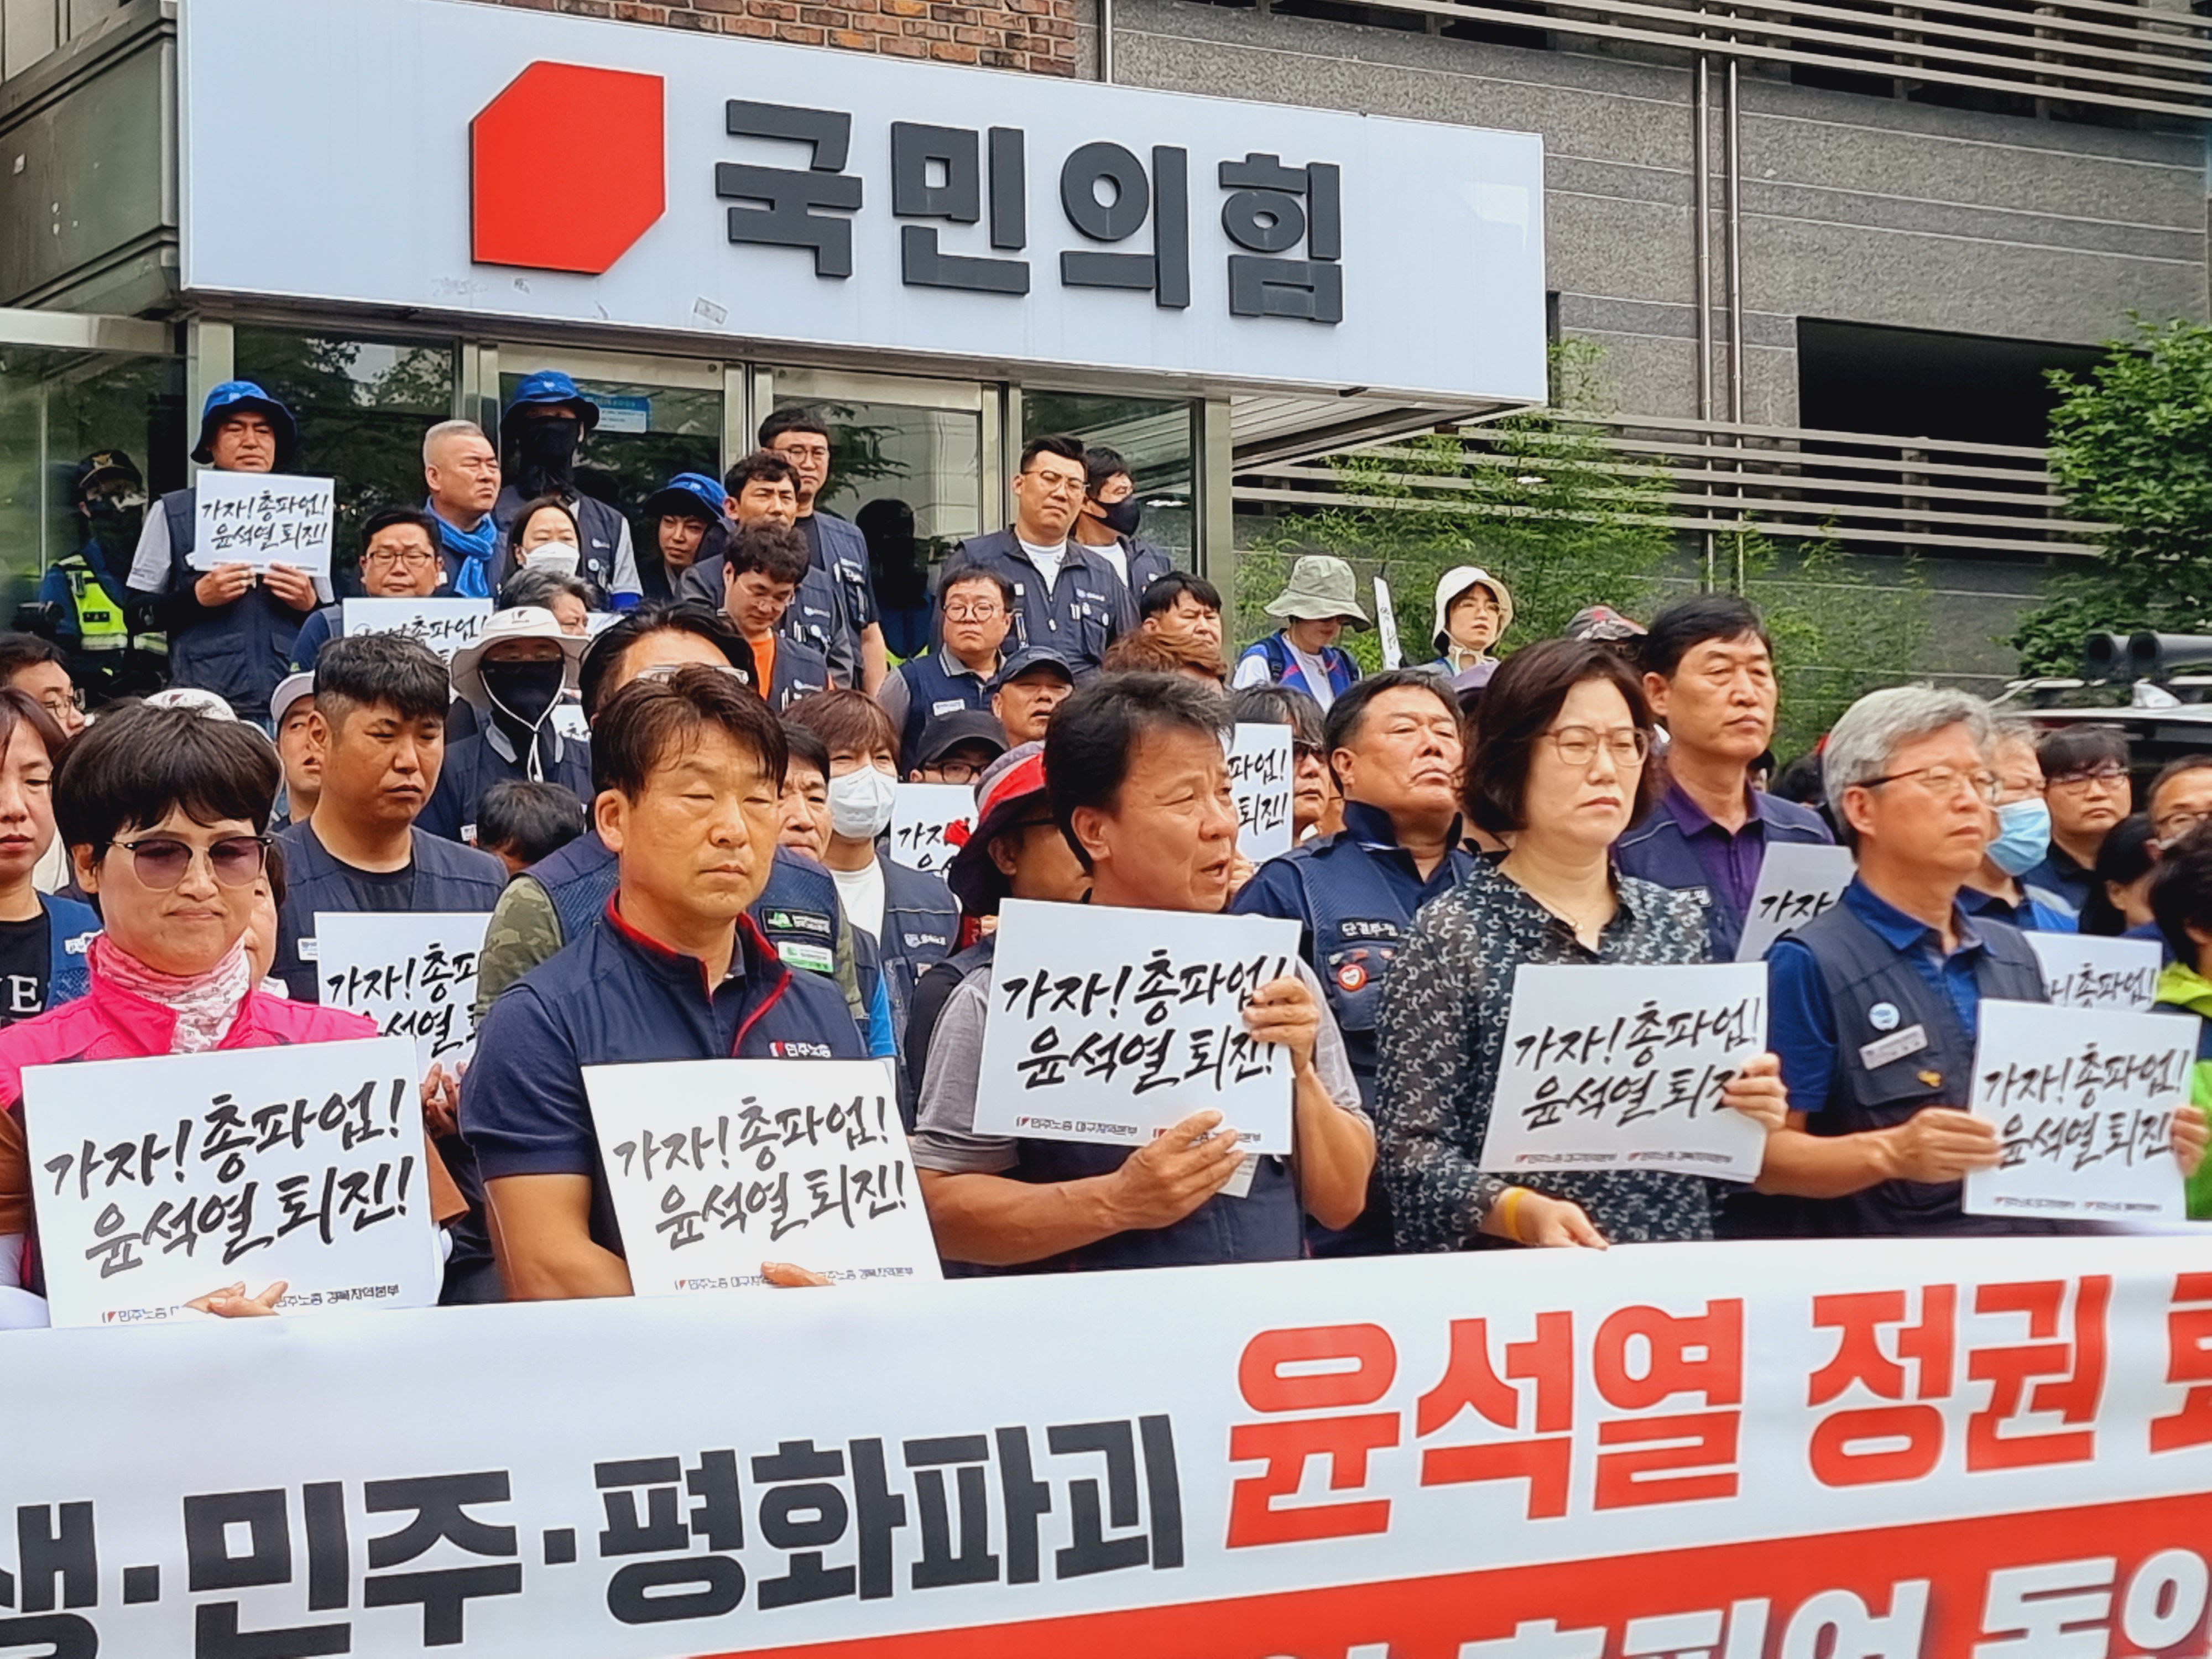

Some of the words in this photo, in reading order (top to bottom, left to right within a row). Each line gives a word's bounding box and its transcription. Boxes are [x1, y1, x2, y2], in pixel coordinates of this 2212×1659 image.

[715, 99, 1343, 324] 국민의힘
[201, 497, 255, 521] 가자!
[257, 490, 328, 522] 총파업!
[211, 522, 279, 551] 윤석열
[280, 521, 328, 550] 퇴진!
[1238, 792, 1288, 836] 퇴진!
[327, 966, 416, 1006] 가자!
[1001, 966, 1133, 1020] 가자!
[1133, 949, 1286, 1026] 총파업!
[1017, 1026, 1180, 1095] 윤석열
[1183, 1025, 1274, 1092] 퇴진!
[1514, 1017, 1625, 1071] 가자!
[1625, 998, 1761, 1068] 총파업!
[1521, 1069, 1660, 1131] 윤석열
[1984, 1057, 2074, 1108] 가자!
[2074, 1042, 2190, 1108] 총파업!
[44, 1119, 193, 1201] 가자!
[201, 1078, 407, 1182] 총파업!
[613, 1116, 730, 1182] 가자!
[738, 1095, 889, 1171] 총파업!
[1999, 1112, 2103, 1172] 윤석열
[85, 1181, 275, 1279] 윤석열
[276, 1156, 415, 1246] 퇴진!
[656, 1171, 809, 1251] 윤석열
[804, 1160, 907, 1229] 퇴진!
[1225, 1297, 1746, 1552] 윤석열
[1805, 1274, 2114, 1488] 정권
